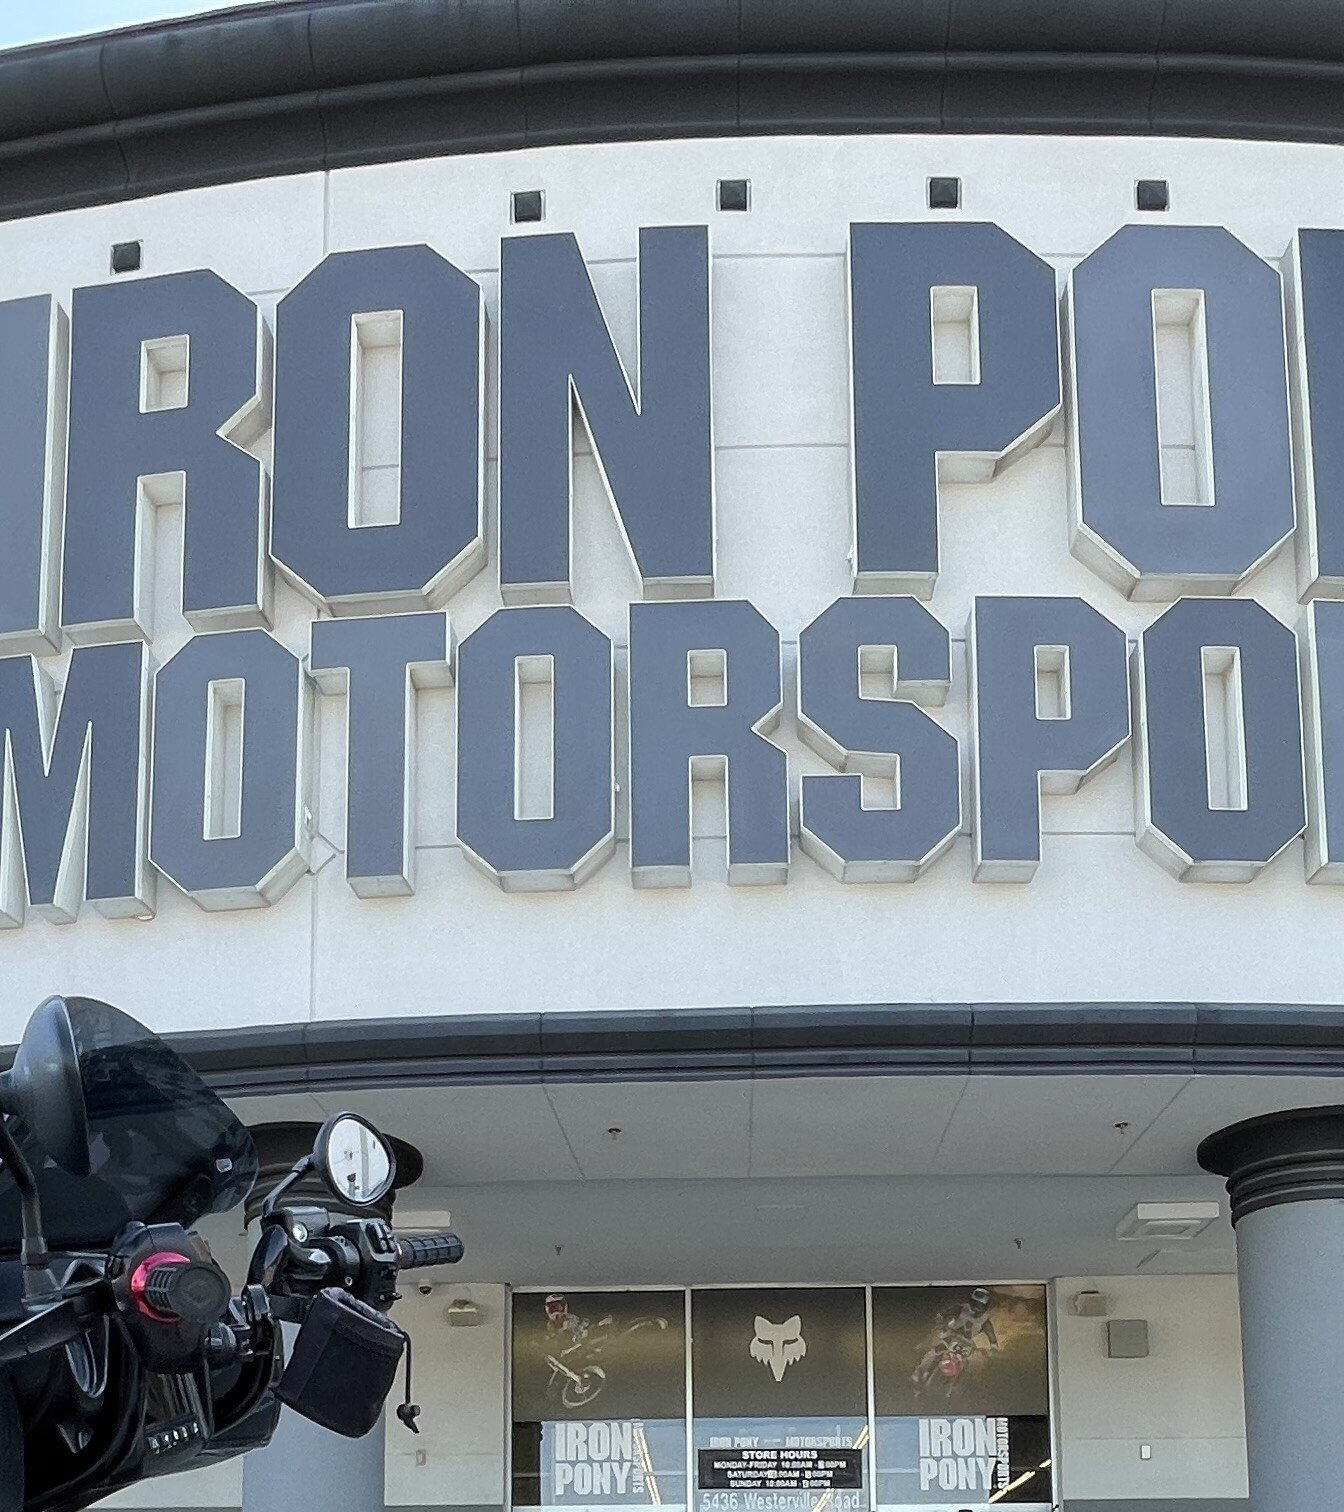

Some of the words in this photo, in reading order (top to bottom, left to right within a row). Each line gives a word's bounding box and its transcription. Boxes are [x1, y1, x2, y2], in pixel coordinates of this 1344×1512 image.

[555, 1422, 632, 1461] IRON
[733, 1437, 760, 1448] PONY
[785, 1436, 853, 1448] MOTORSPORTS
[918, 1418, 996, 1457] IRON
[713, 1460, 778, 1469] MONDAY-FRIDAY
[742, 1450, 778, 1460] STORE
[780, 1450, 818, 1460] HOURS
[996, 1417, 1010, 1490] MOTORSPORTS
[555, 1461, 632, 1495] PONY
[729, 1480, 762, 1488] SUNDAY
[919, 1457, 997, 1491] PONY
[702, 1492, 739, 1511] 5436
[745, 1491, 819, 1510] Westerville
